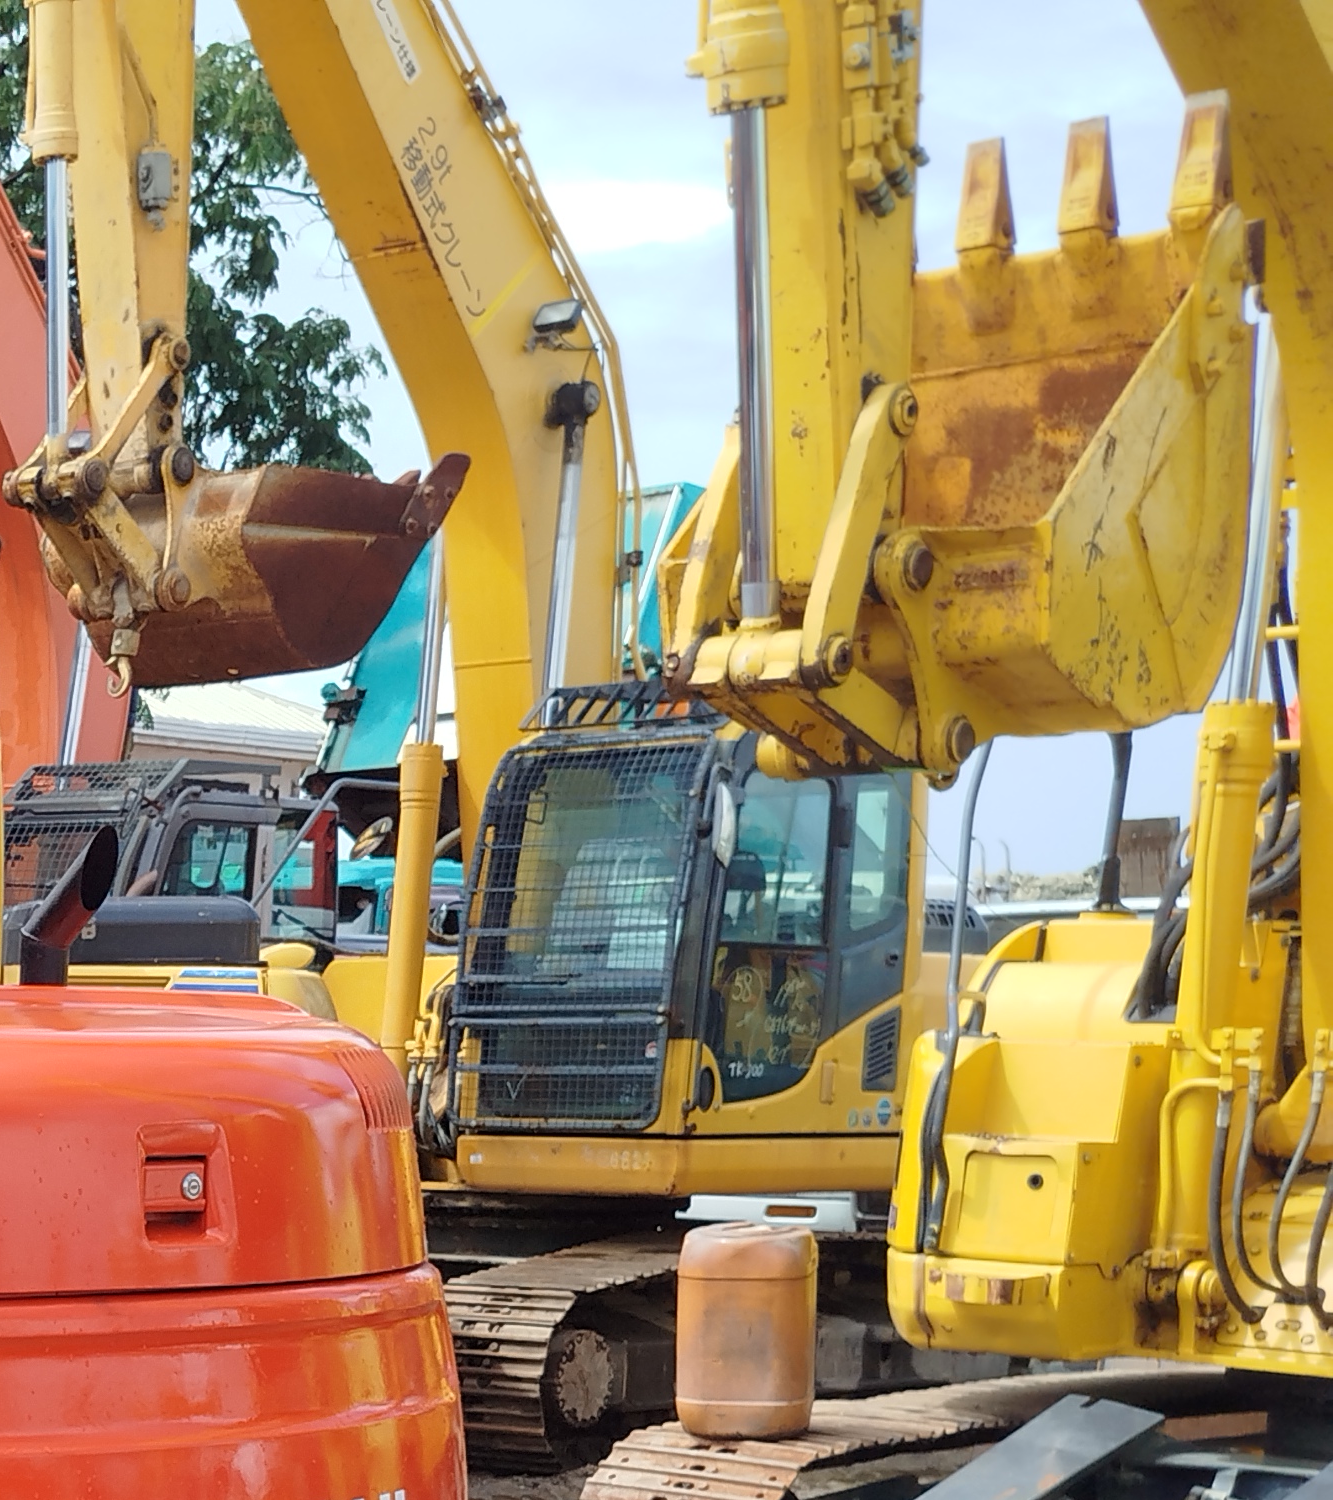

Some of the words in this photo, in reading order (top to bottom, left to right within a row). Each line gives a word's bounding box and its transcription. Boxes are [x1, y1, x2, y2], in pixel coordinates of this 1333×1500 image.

[417, 117, 452, 186] 2.9t
[401, 136, 486, 317] 移動式クレーン
